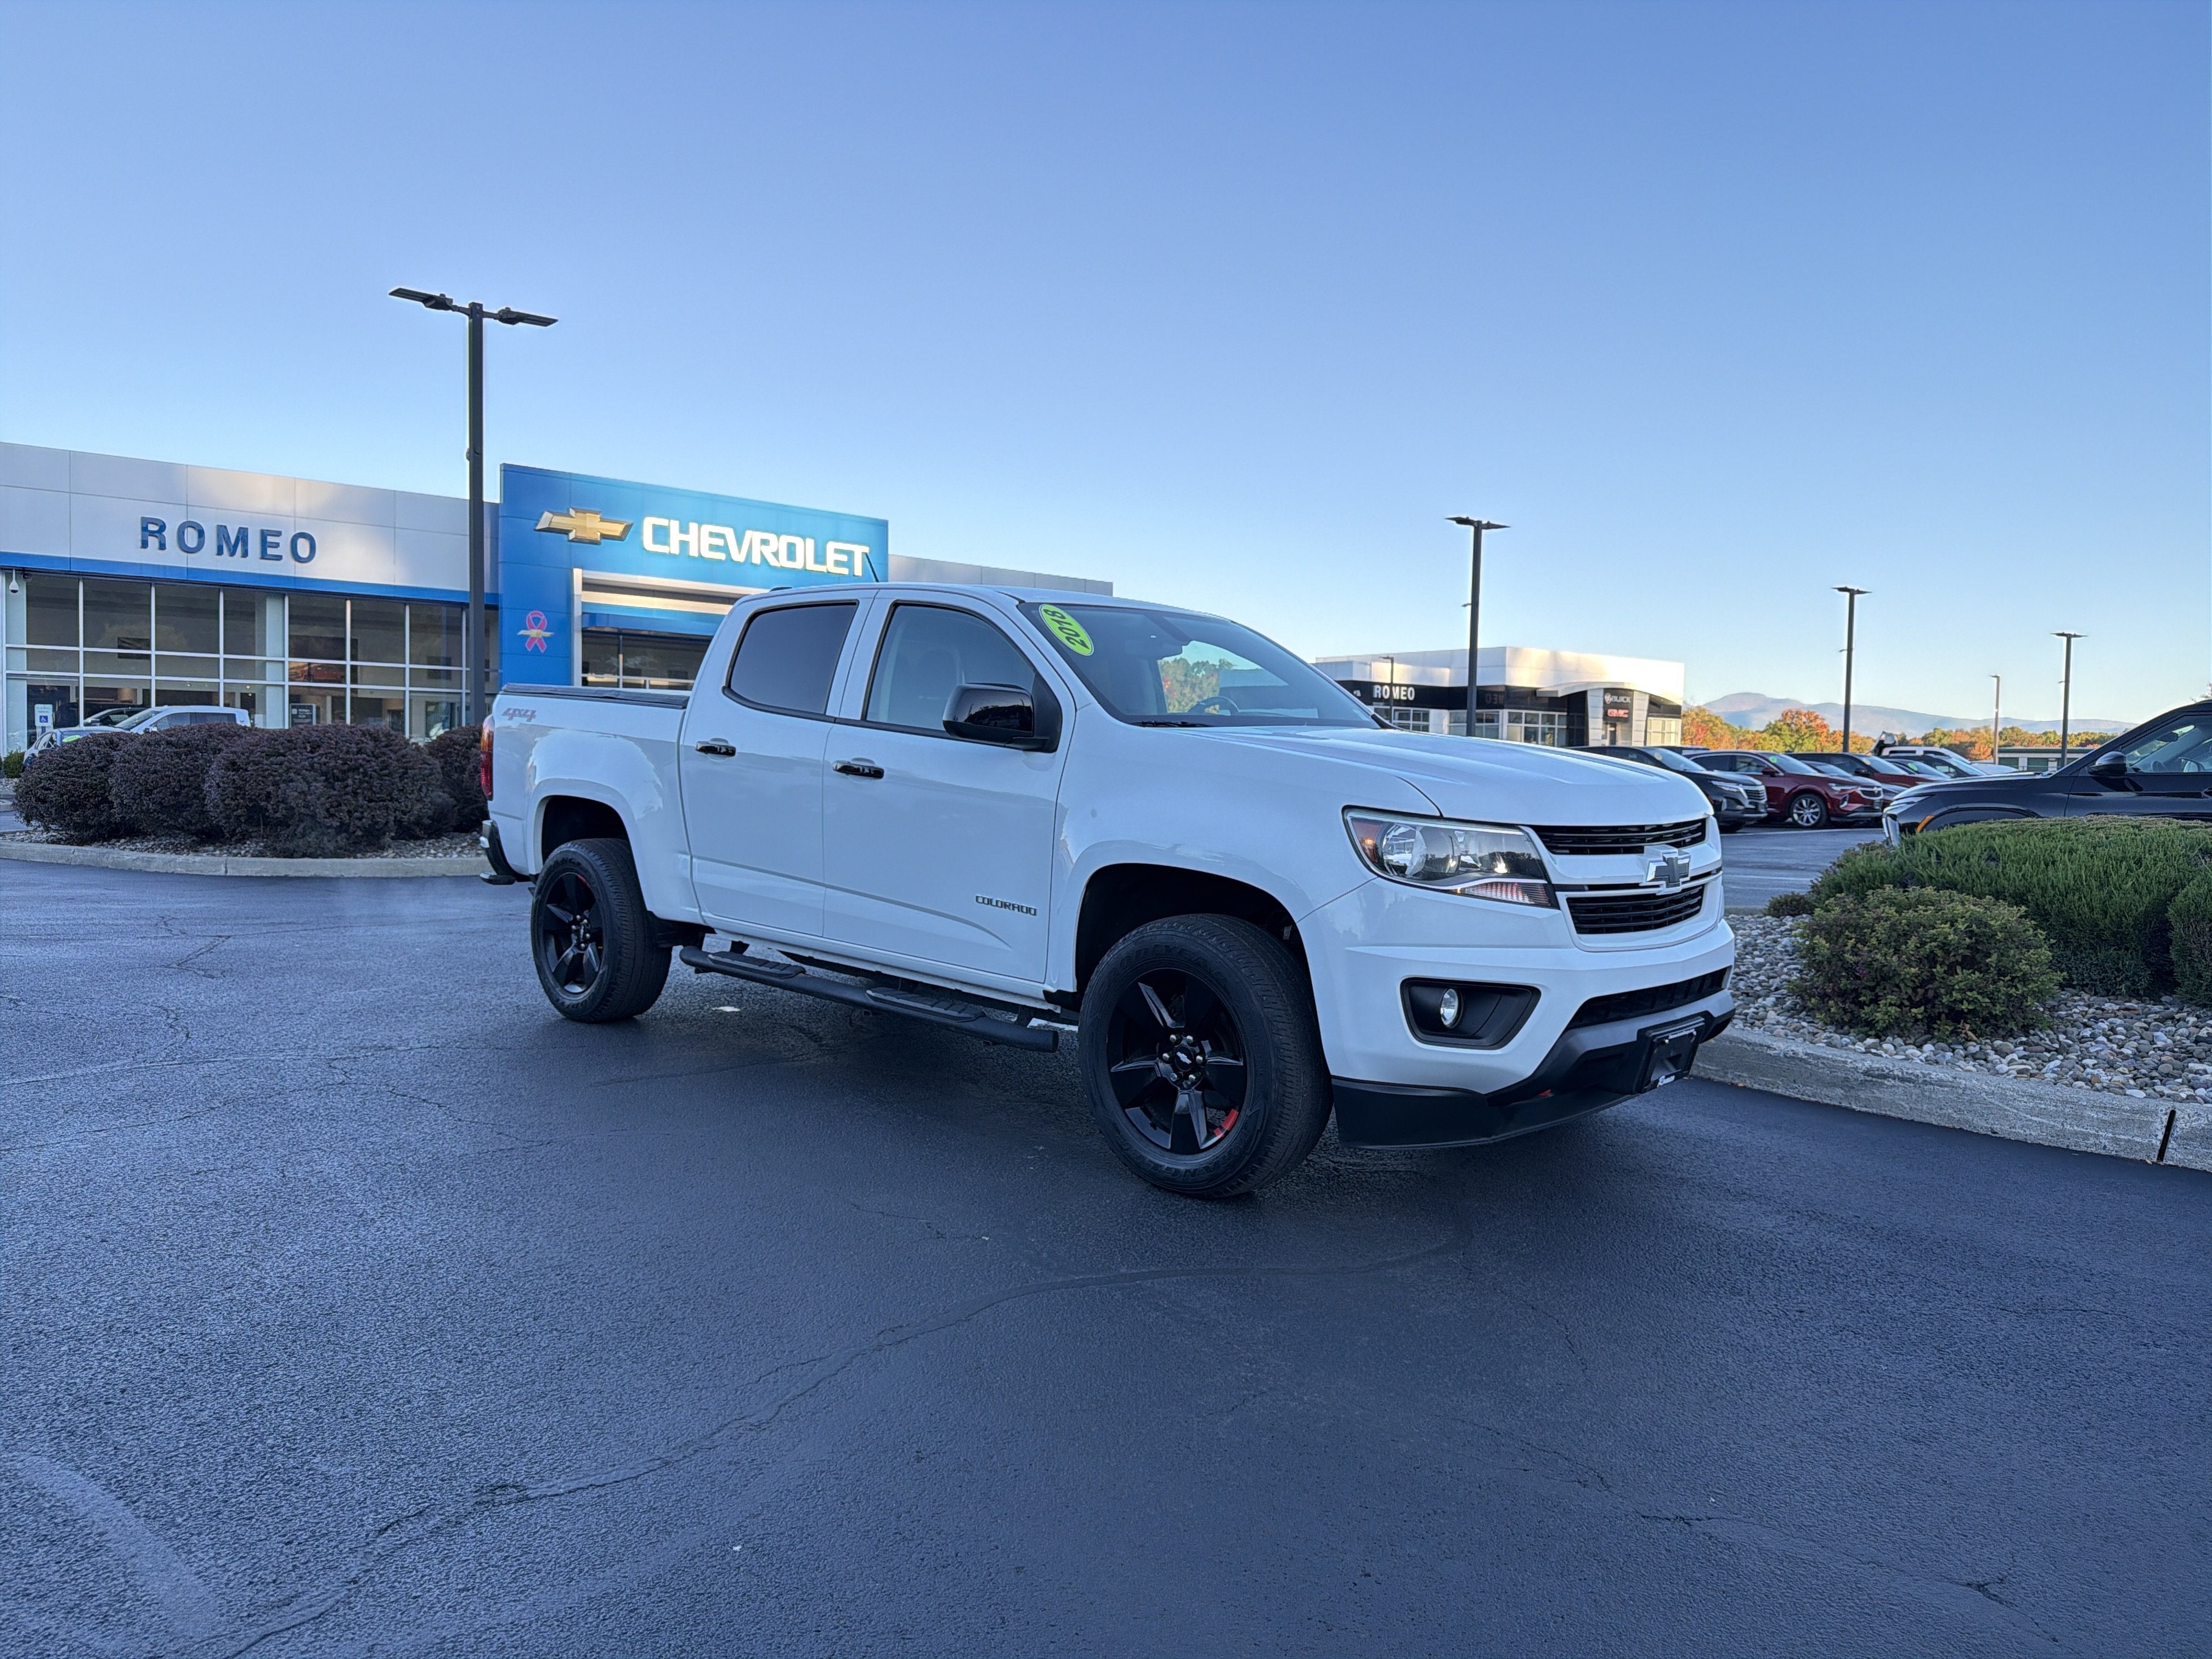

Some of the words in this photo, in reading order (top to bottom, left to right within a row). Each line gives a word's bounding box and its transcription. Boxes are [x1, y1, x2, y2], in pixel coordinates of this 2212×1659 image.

[140, 516, 317, 563] ROMEO
[643, 517, 870, 577] CHEVROLET
[1043, 608, 1091, 650] 2018
[1373, 685, 1415, 701] ROMEO
[1607, 708, 1629, 718] GMC
[975, 895, 1037, 916] COLORADO
